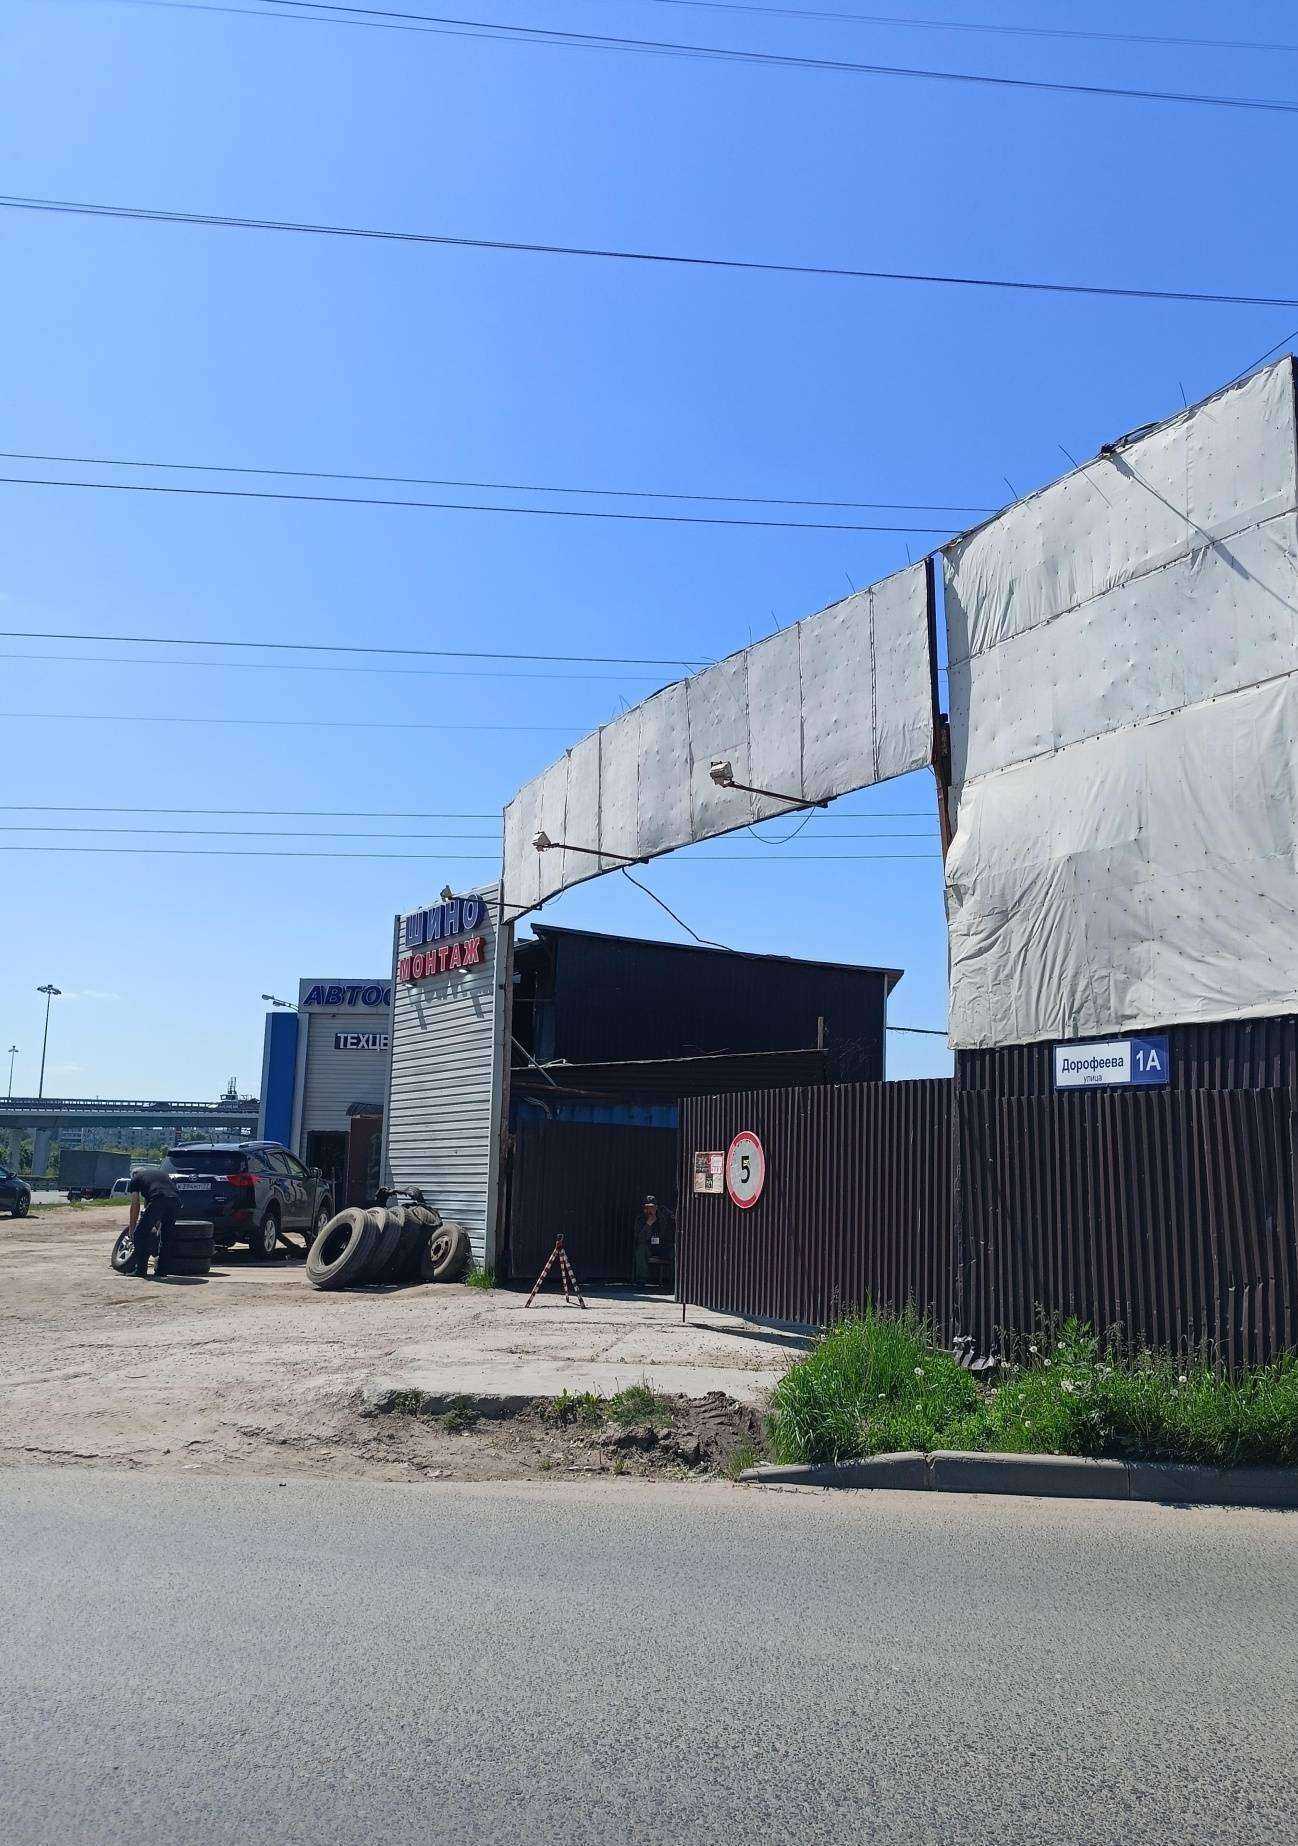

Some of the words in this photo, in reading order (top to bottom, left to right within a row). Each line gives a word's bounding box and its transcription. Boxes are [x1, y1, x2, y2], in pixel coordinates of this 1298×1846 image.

[406, 896, 482, 947] ШИНО
[400, 938, 480, 981] МОНТАЖ
[1062, 1057, 1124, 1073] Дорофеева
[1136, 1049, 1161, 1071] 1А
[1083, 1074, 1103, 1083] улица
[741, 1155, 750, 1183] 5
